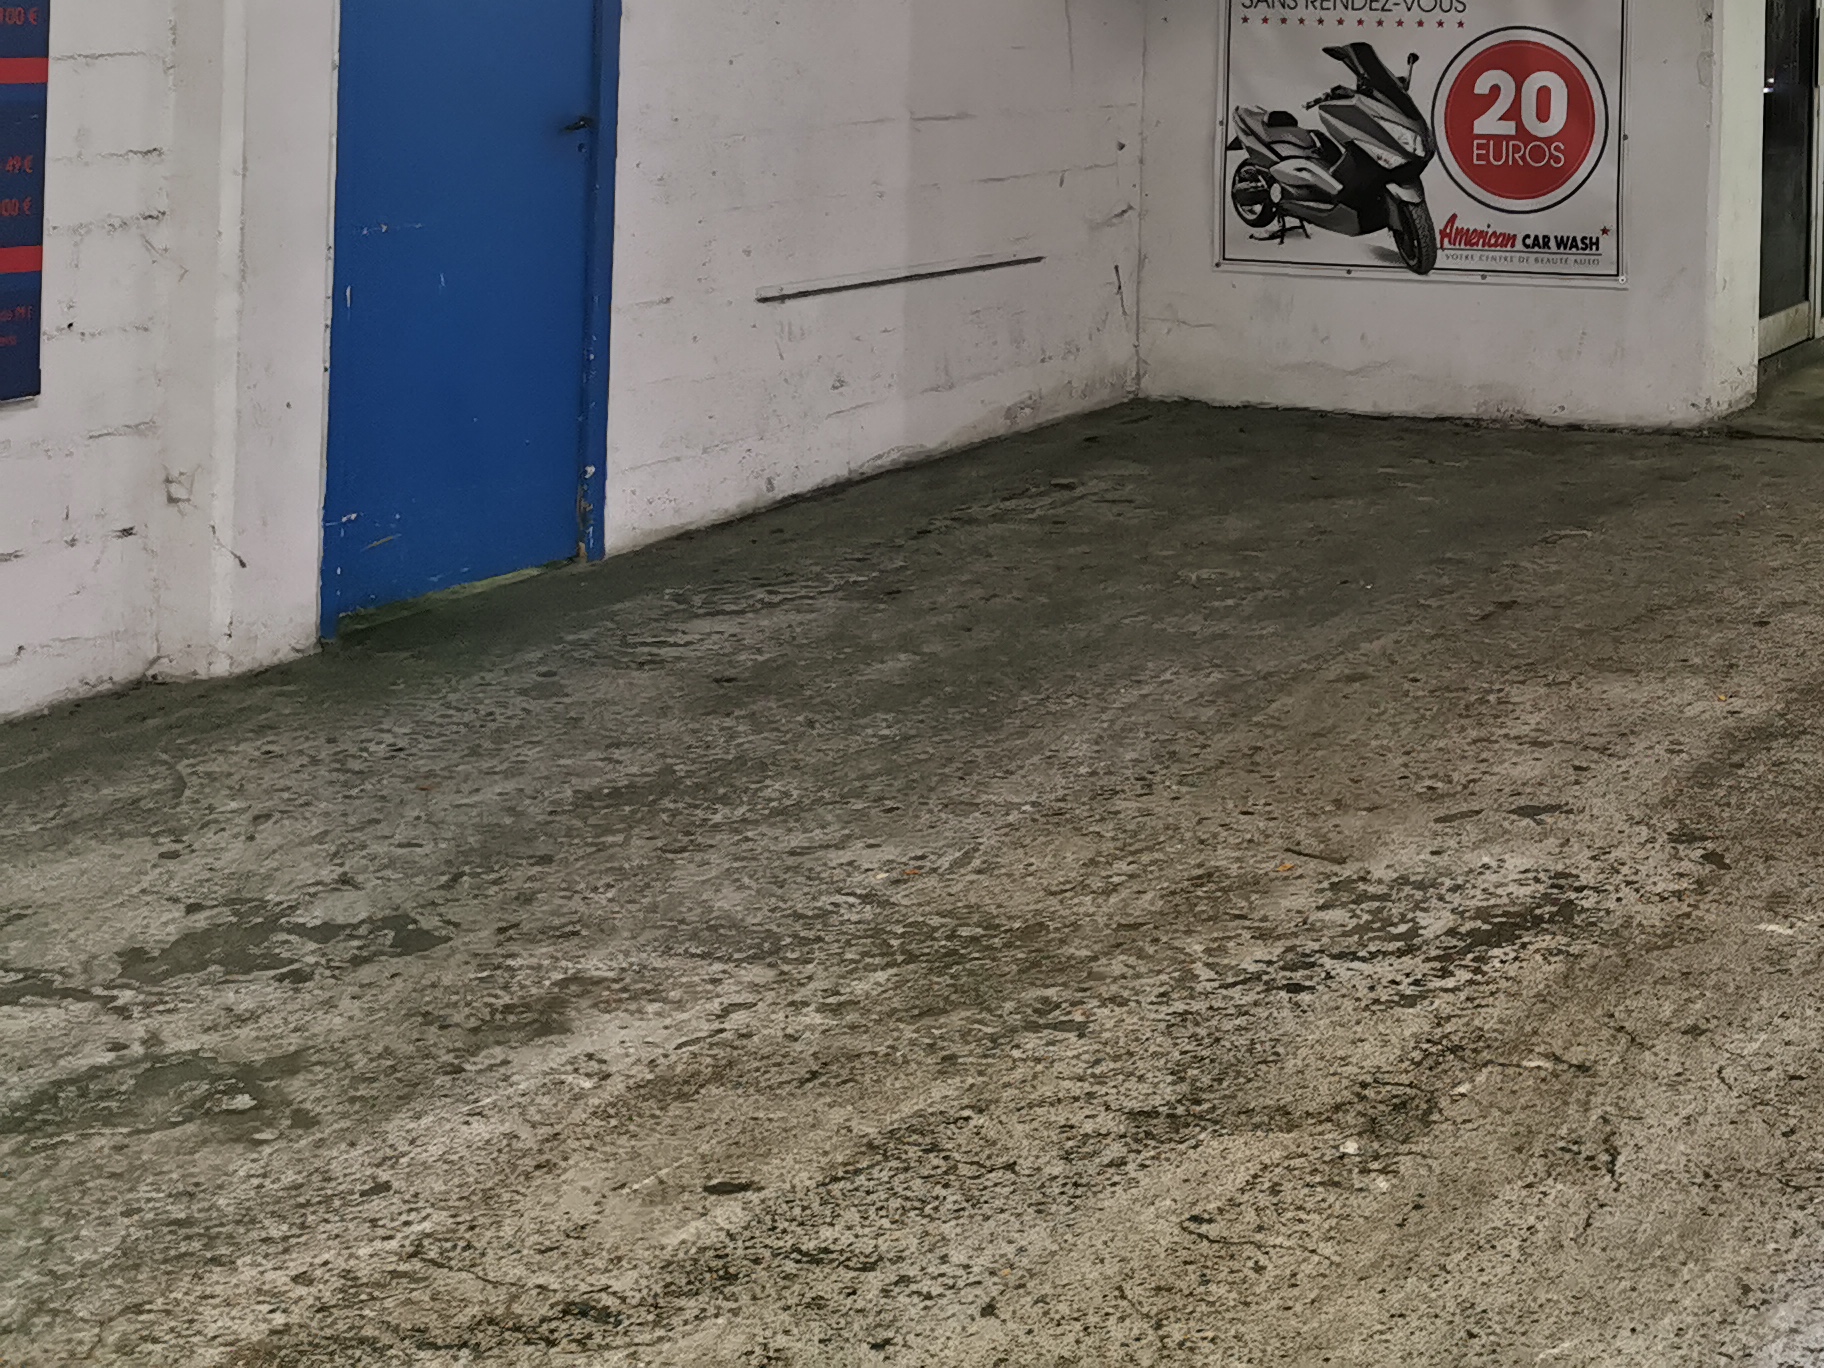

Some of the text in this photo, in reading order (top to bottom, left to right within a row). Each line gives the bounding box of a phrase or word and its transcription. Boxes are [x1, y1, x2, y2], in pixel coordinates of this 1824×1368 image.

[1473, 68, 1569, 139] 20
[1473, 140, 1565, 168] EUROS
[1439, 213, 1600, 252] American CAR WASH
